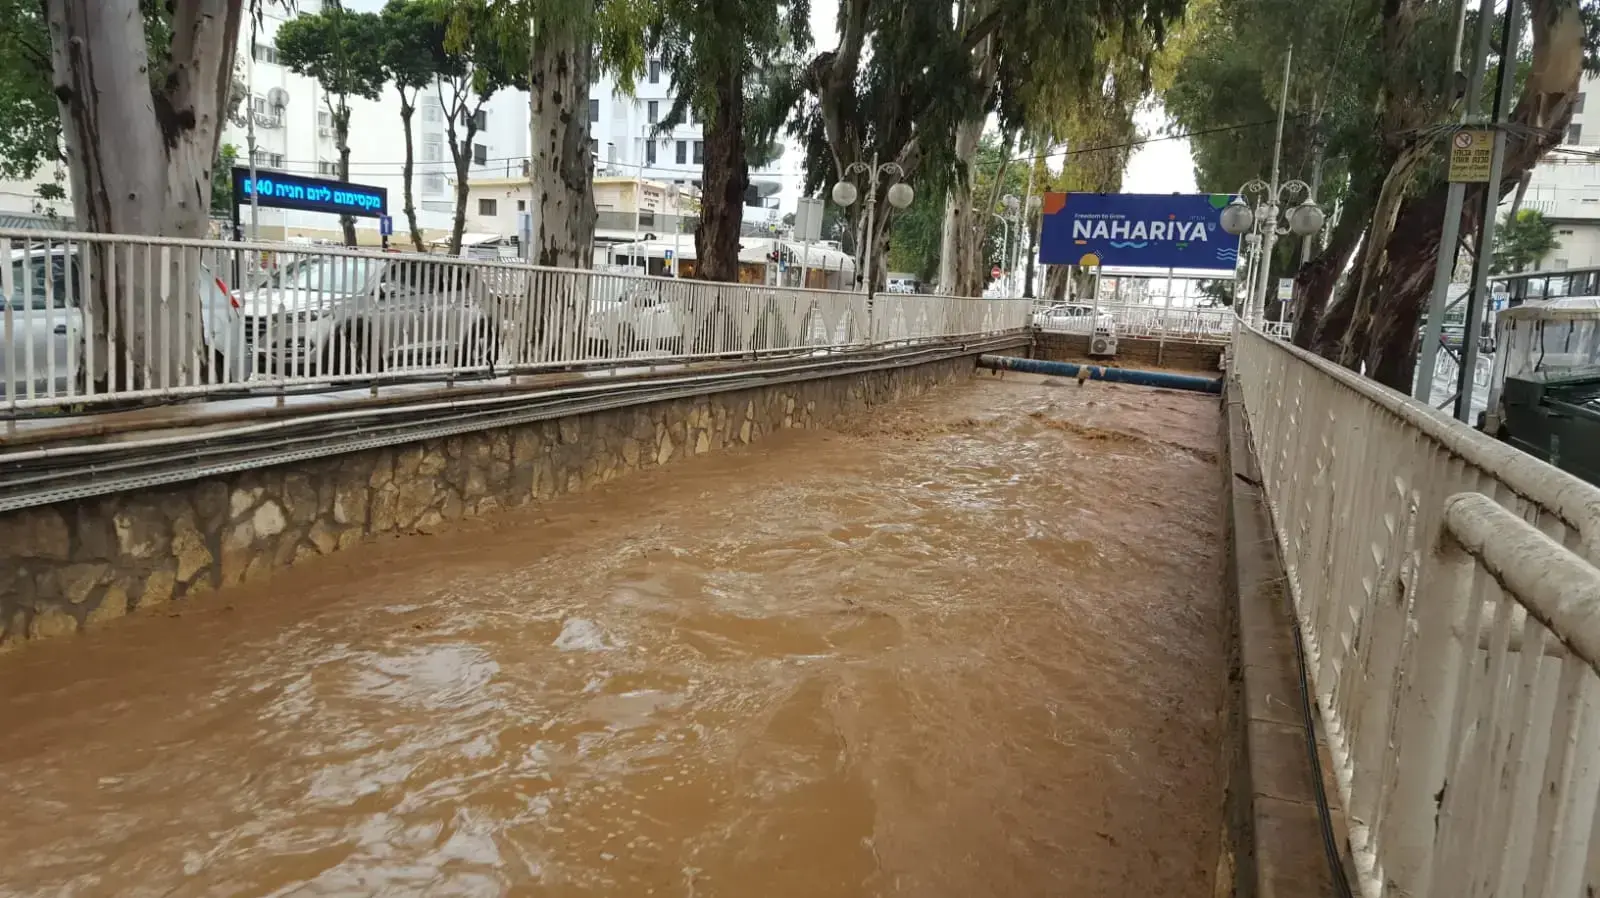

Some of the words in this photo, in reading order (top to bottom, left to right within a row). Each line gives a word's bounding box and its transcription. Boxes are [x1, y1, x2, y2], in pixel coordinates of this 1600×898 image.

[276, 183, 304, 199] חניה
[306, 186, 332, 201] ליום
[334, 191, 381, 210] מקסימום
[1072, 218, 1208, 242] NAHARIYA
